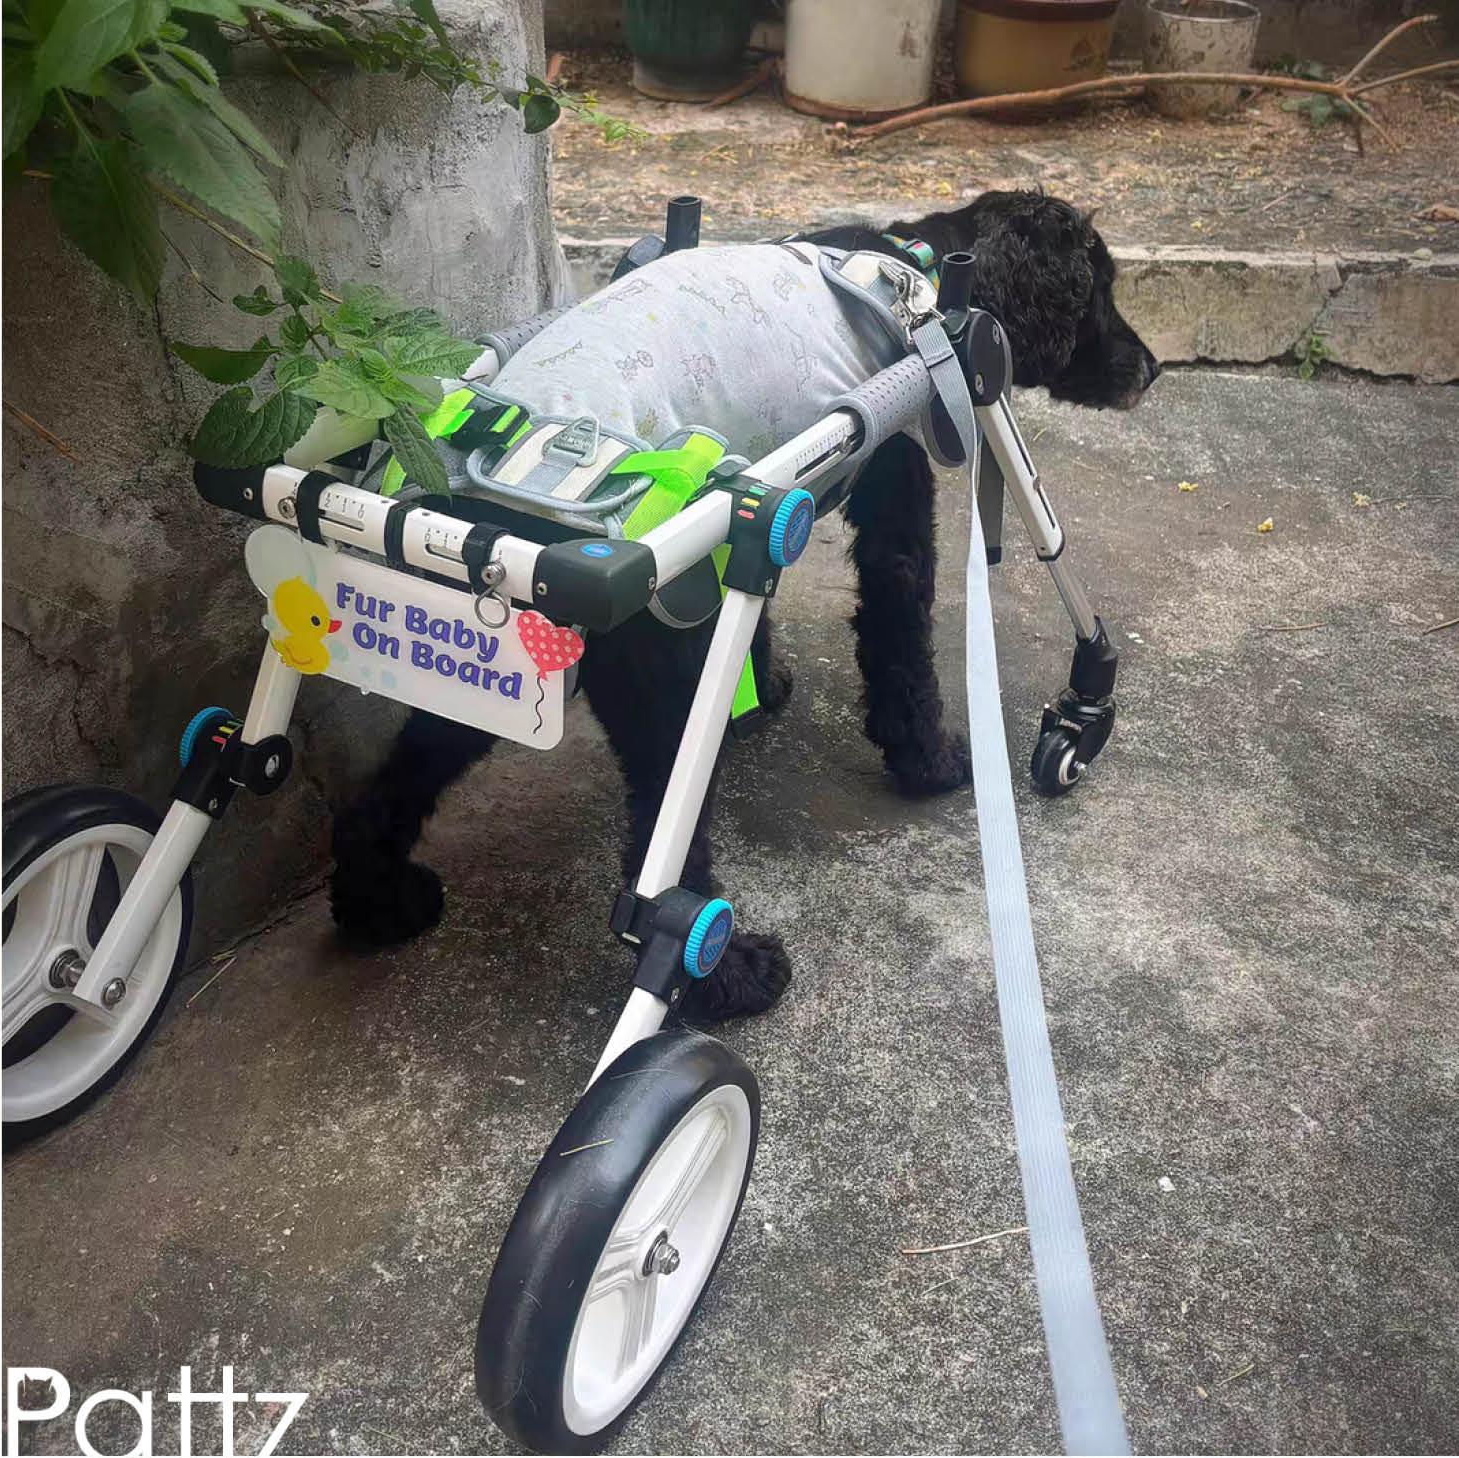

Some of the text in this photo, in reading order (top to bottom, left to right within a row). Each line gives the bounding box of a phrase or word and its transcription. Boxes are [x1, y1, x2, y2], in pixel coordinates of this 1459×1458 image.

[335, 582, 500, 664] Fur Baby
[353, 621, 523, 700] On Board
